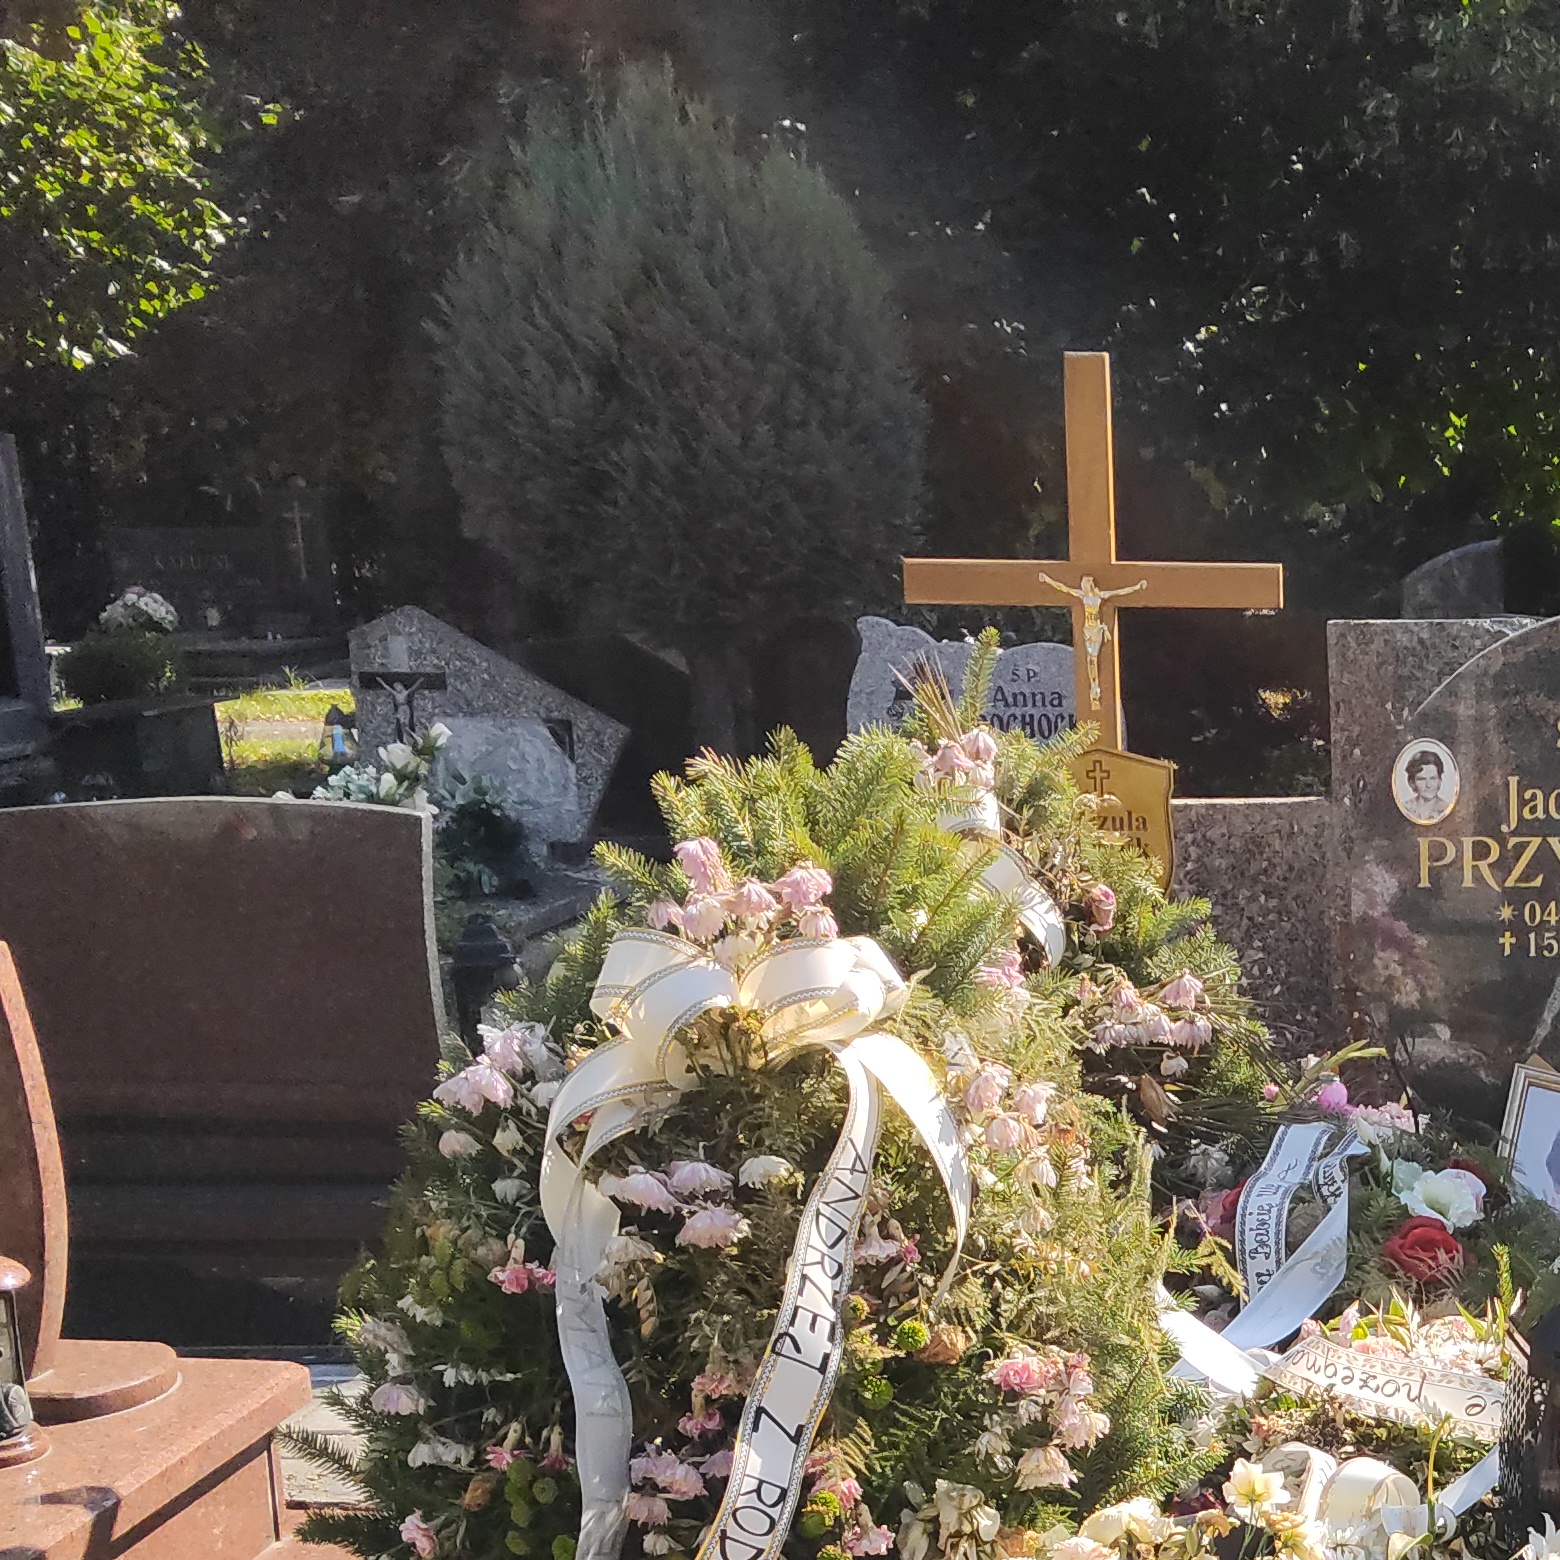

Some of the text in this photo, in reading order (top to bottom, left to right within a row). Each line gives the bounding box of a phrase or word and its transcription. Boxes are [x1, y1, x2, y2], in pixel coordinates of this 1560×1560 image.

[992, 685, 1065, 708] Anna
[776, 1136, 868, 1377] ANDRZEJ
[752, 1404, 802, 1446] Z
